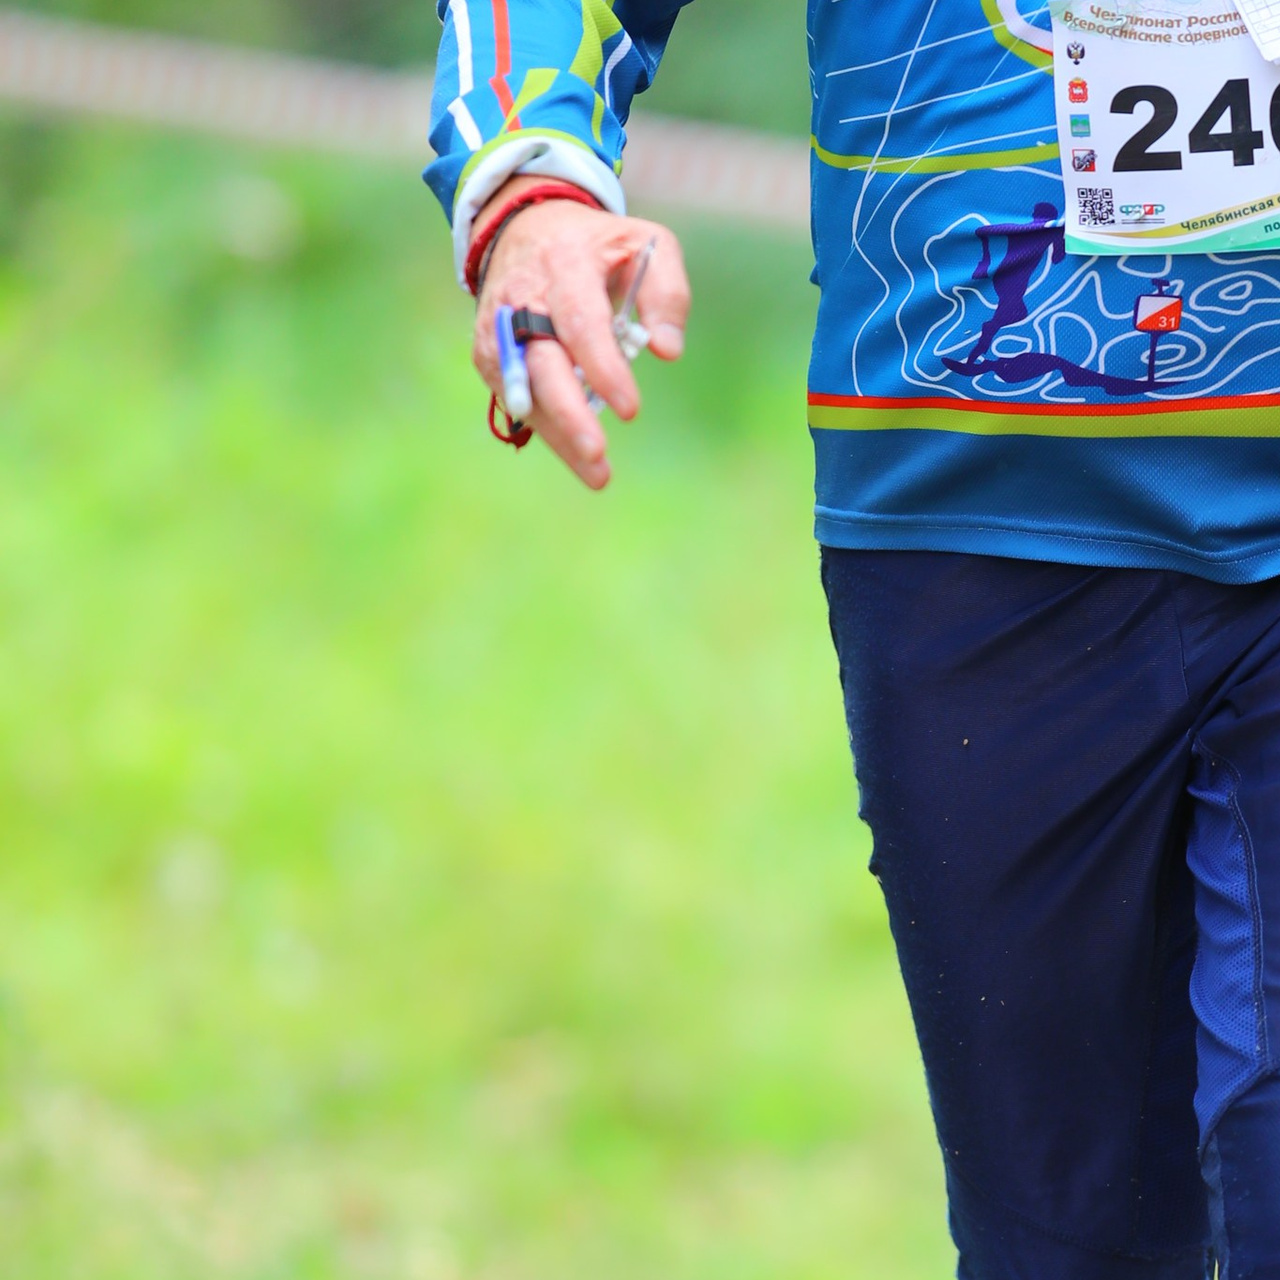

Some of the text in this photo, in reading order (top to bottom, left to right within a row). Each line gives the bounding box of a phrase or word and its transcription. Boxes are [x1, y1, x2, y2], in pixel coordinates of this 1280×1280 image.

[1063, 10, 1249, 43] Всероссийские соревнов
[1180, 199, 1274, 231] Челябинская
[1158, 316, 1176, 328] 31
